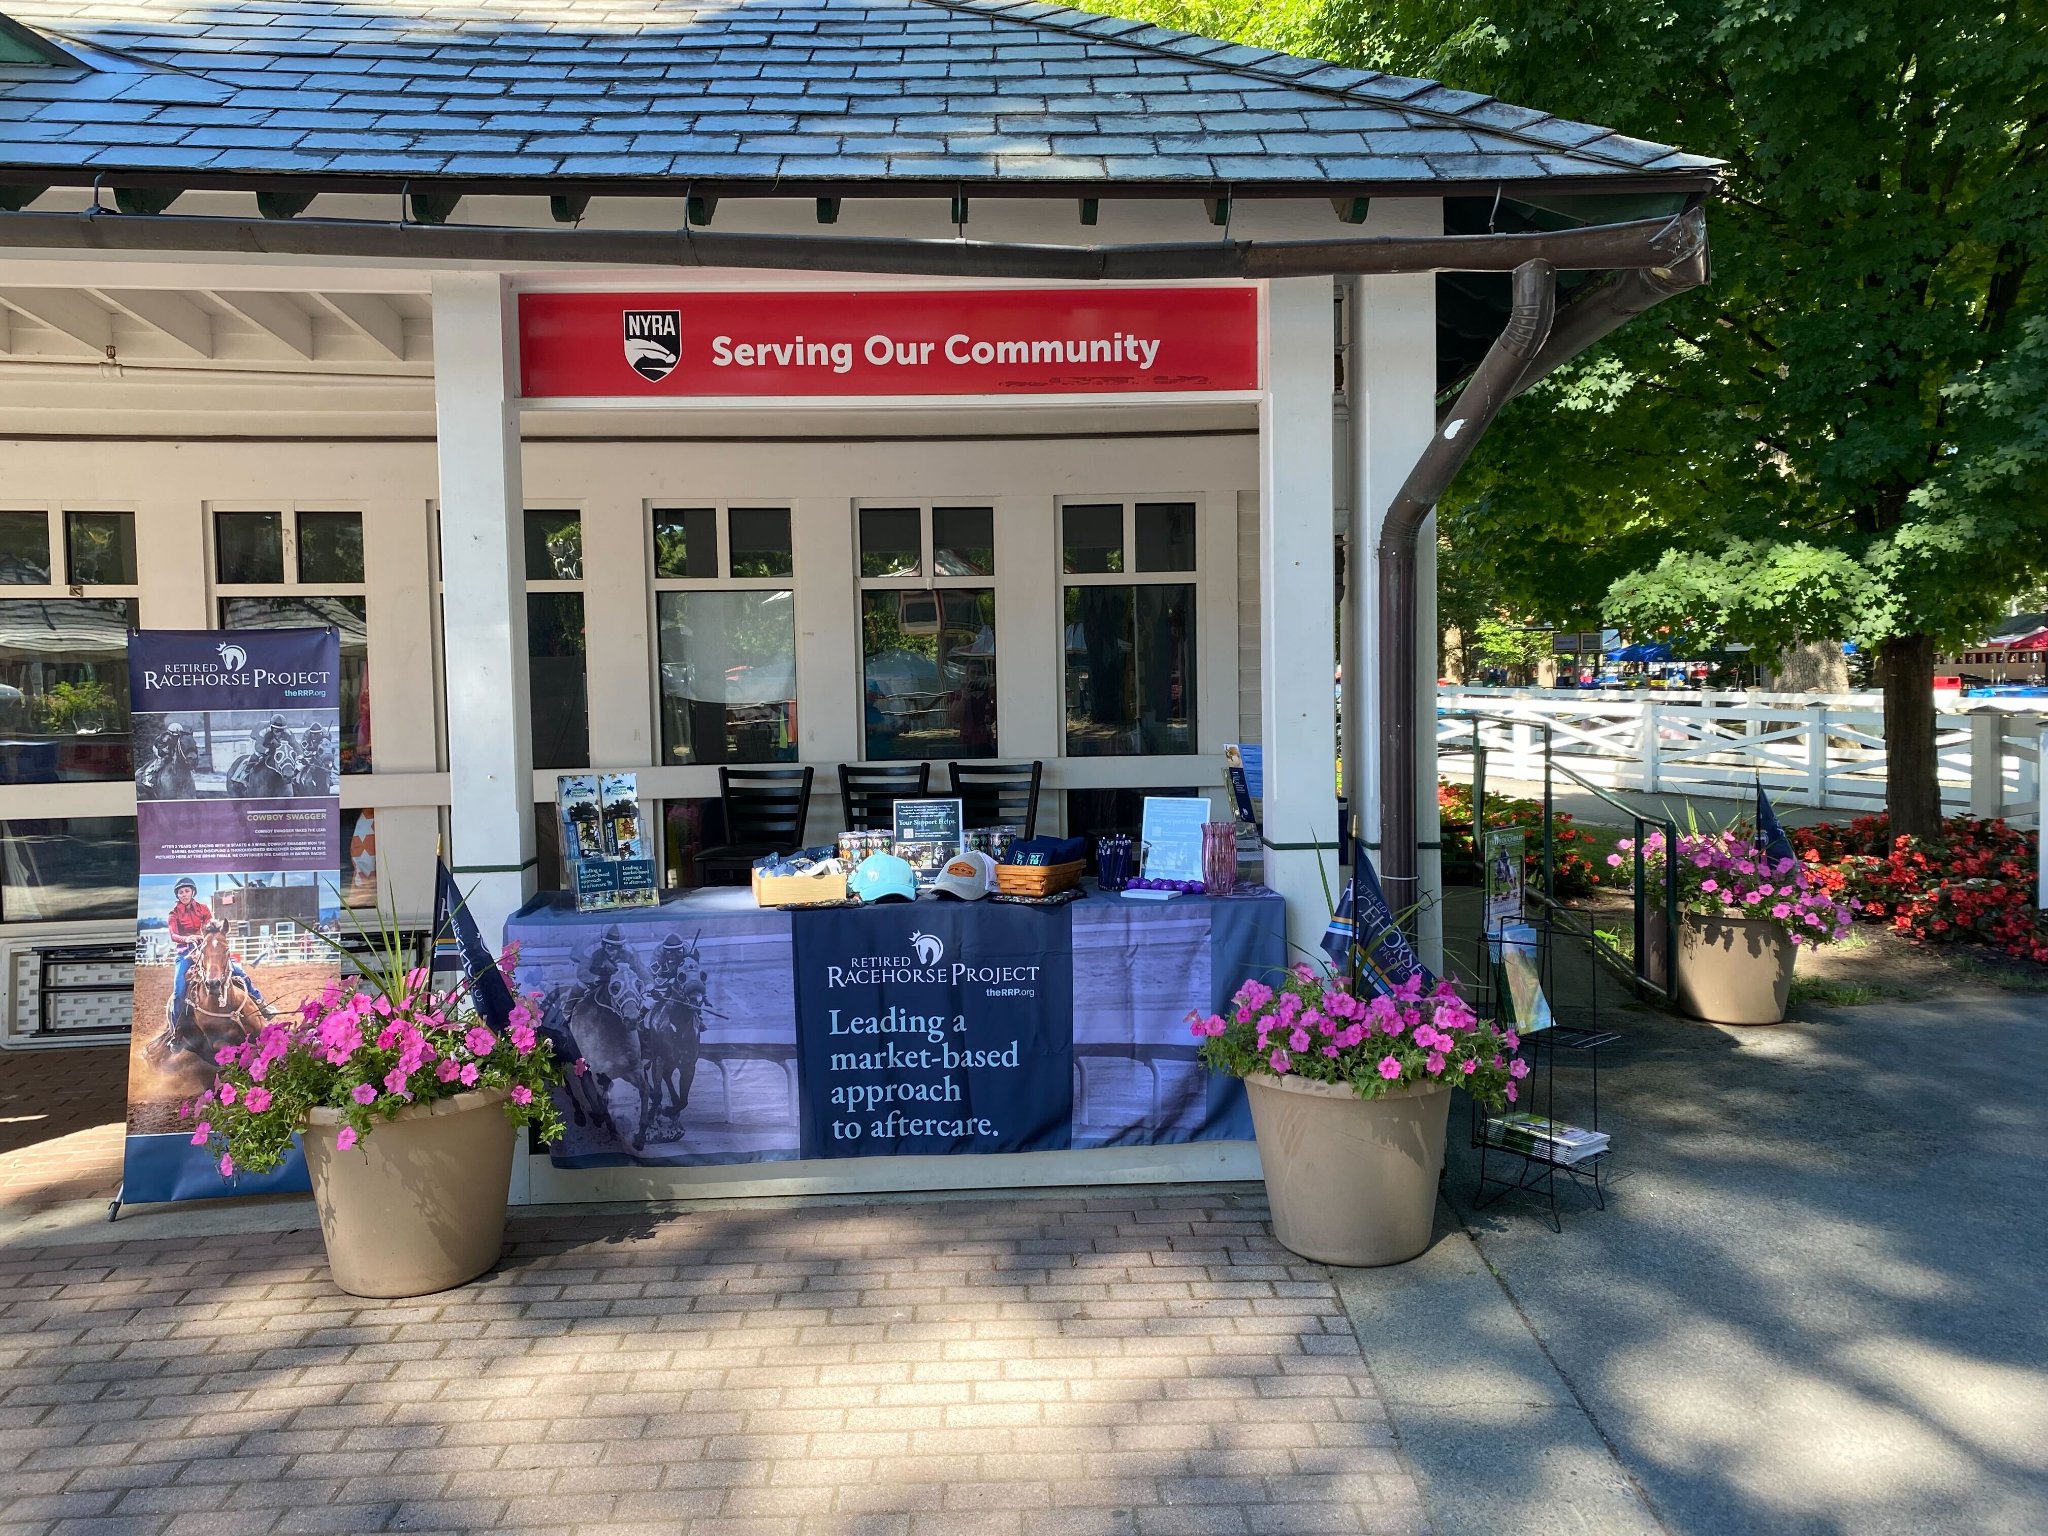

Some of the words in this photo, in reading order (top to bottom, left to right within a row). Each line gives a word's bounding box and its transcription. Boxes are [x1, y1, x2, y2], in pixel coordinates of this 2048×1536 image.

[628, 314, 677, 337] NYRA
[711, 335, 853, 374] Serving
[863, 333, 935, 366] Our
[944, 331, 1161, 370] Community
[143, 670, 251, 690] RACEHORSE
[253, 668, 331, 688] PROJECT
[164, 663, 219, 674] RETIRED
[284, 689, 326, 698] theRRP.org
[898, 818, 914, 826] Your
[913, 818, 938, 827] Support
[850, 956, 911, 968] RETIRED
[826, 965, 948, 988] RACEHORSE
[951, 962, 1040, 987] PROJECT
[986, 988, 1035, 998] theRRP.org
[828, 1005, 945, 1043] Leading
[952, 1014, 969, 1033] a
[829, 1039, 1020, 1071] market-based
[830, 1075, 962, 1113] approach
[831, 1119, 862, 1140] to
[870, 1110, 1000, 1138] aftercare.
